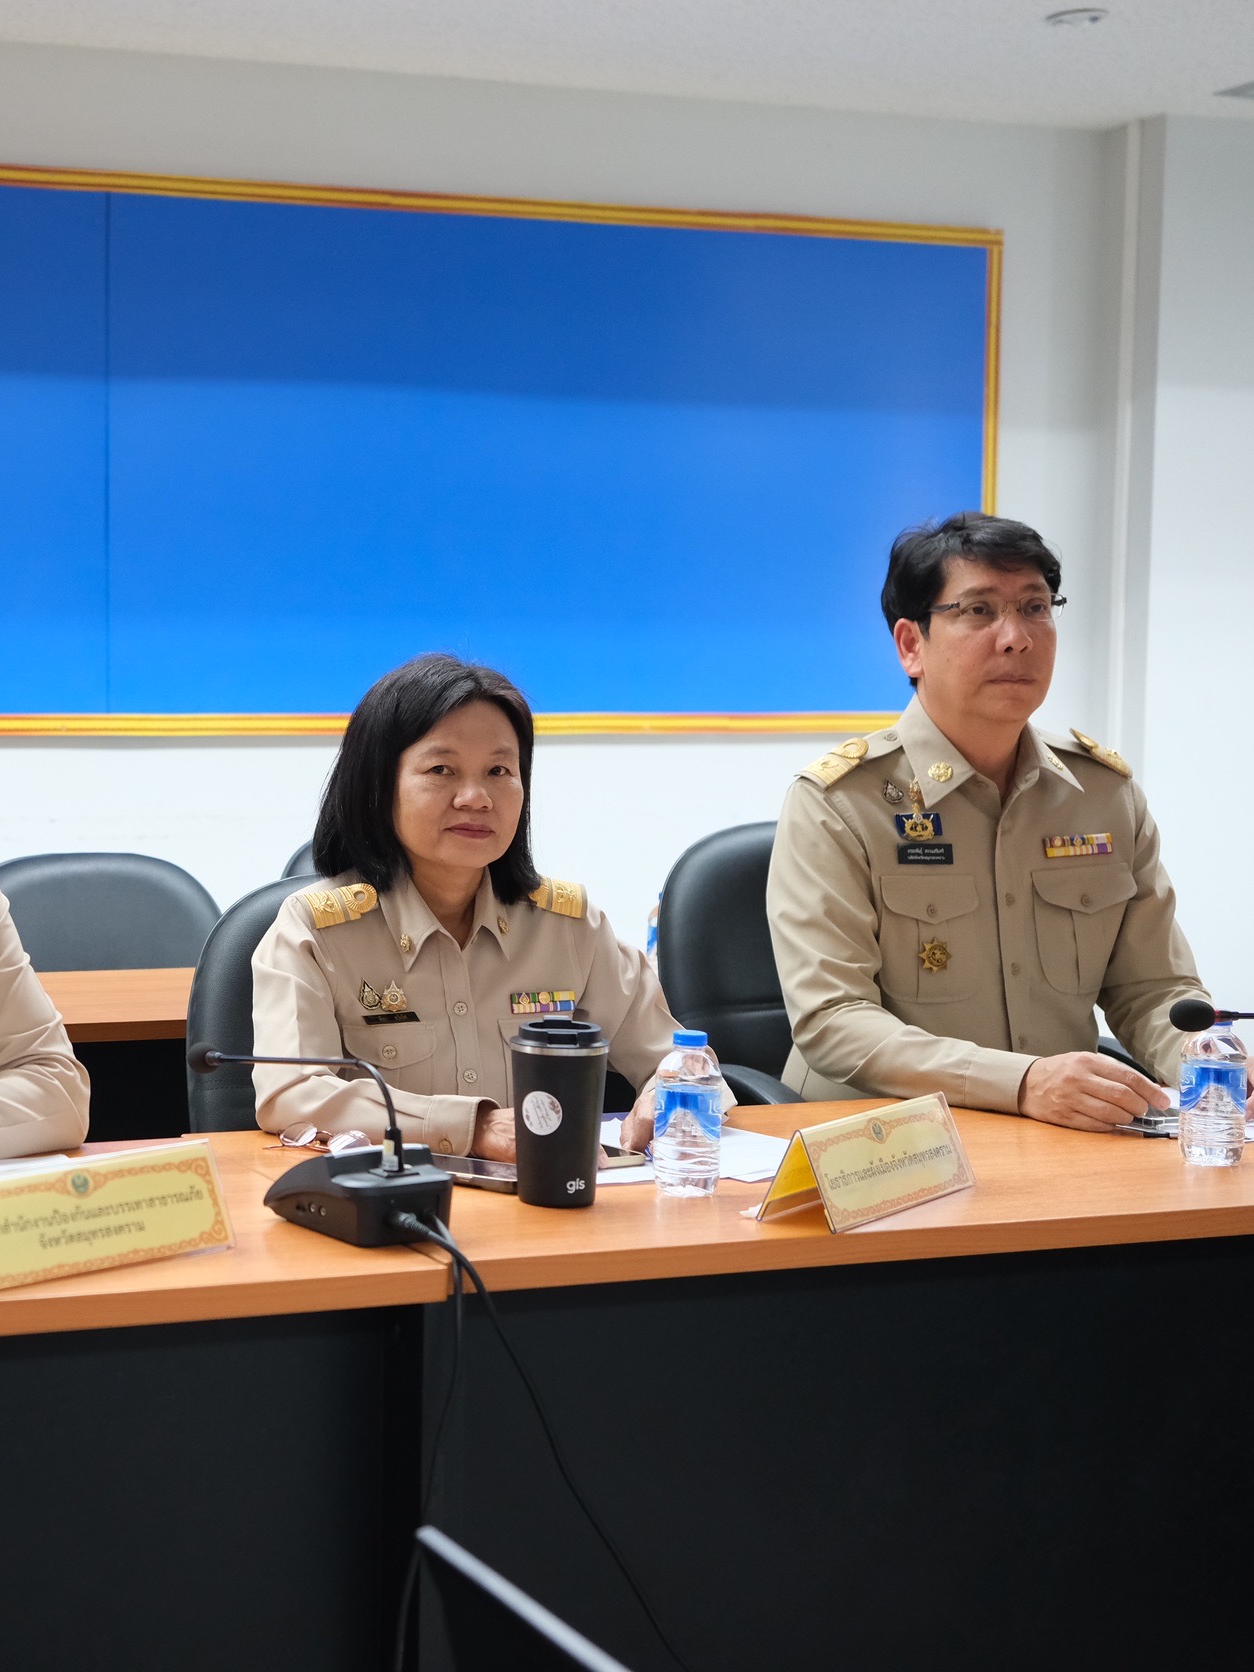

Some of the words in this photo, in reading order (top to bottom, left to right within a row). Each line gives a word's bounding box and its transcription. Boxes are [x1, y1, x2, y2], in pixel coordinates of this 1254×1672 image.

[824, 1144, 952, 1191] โยธาธิการและผังเมืองจังหวัดสมุทรสงคราม
[38, 1220, 146, 1250] จังหวัดสมุทรสงคราม
